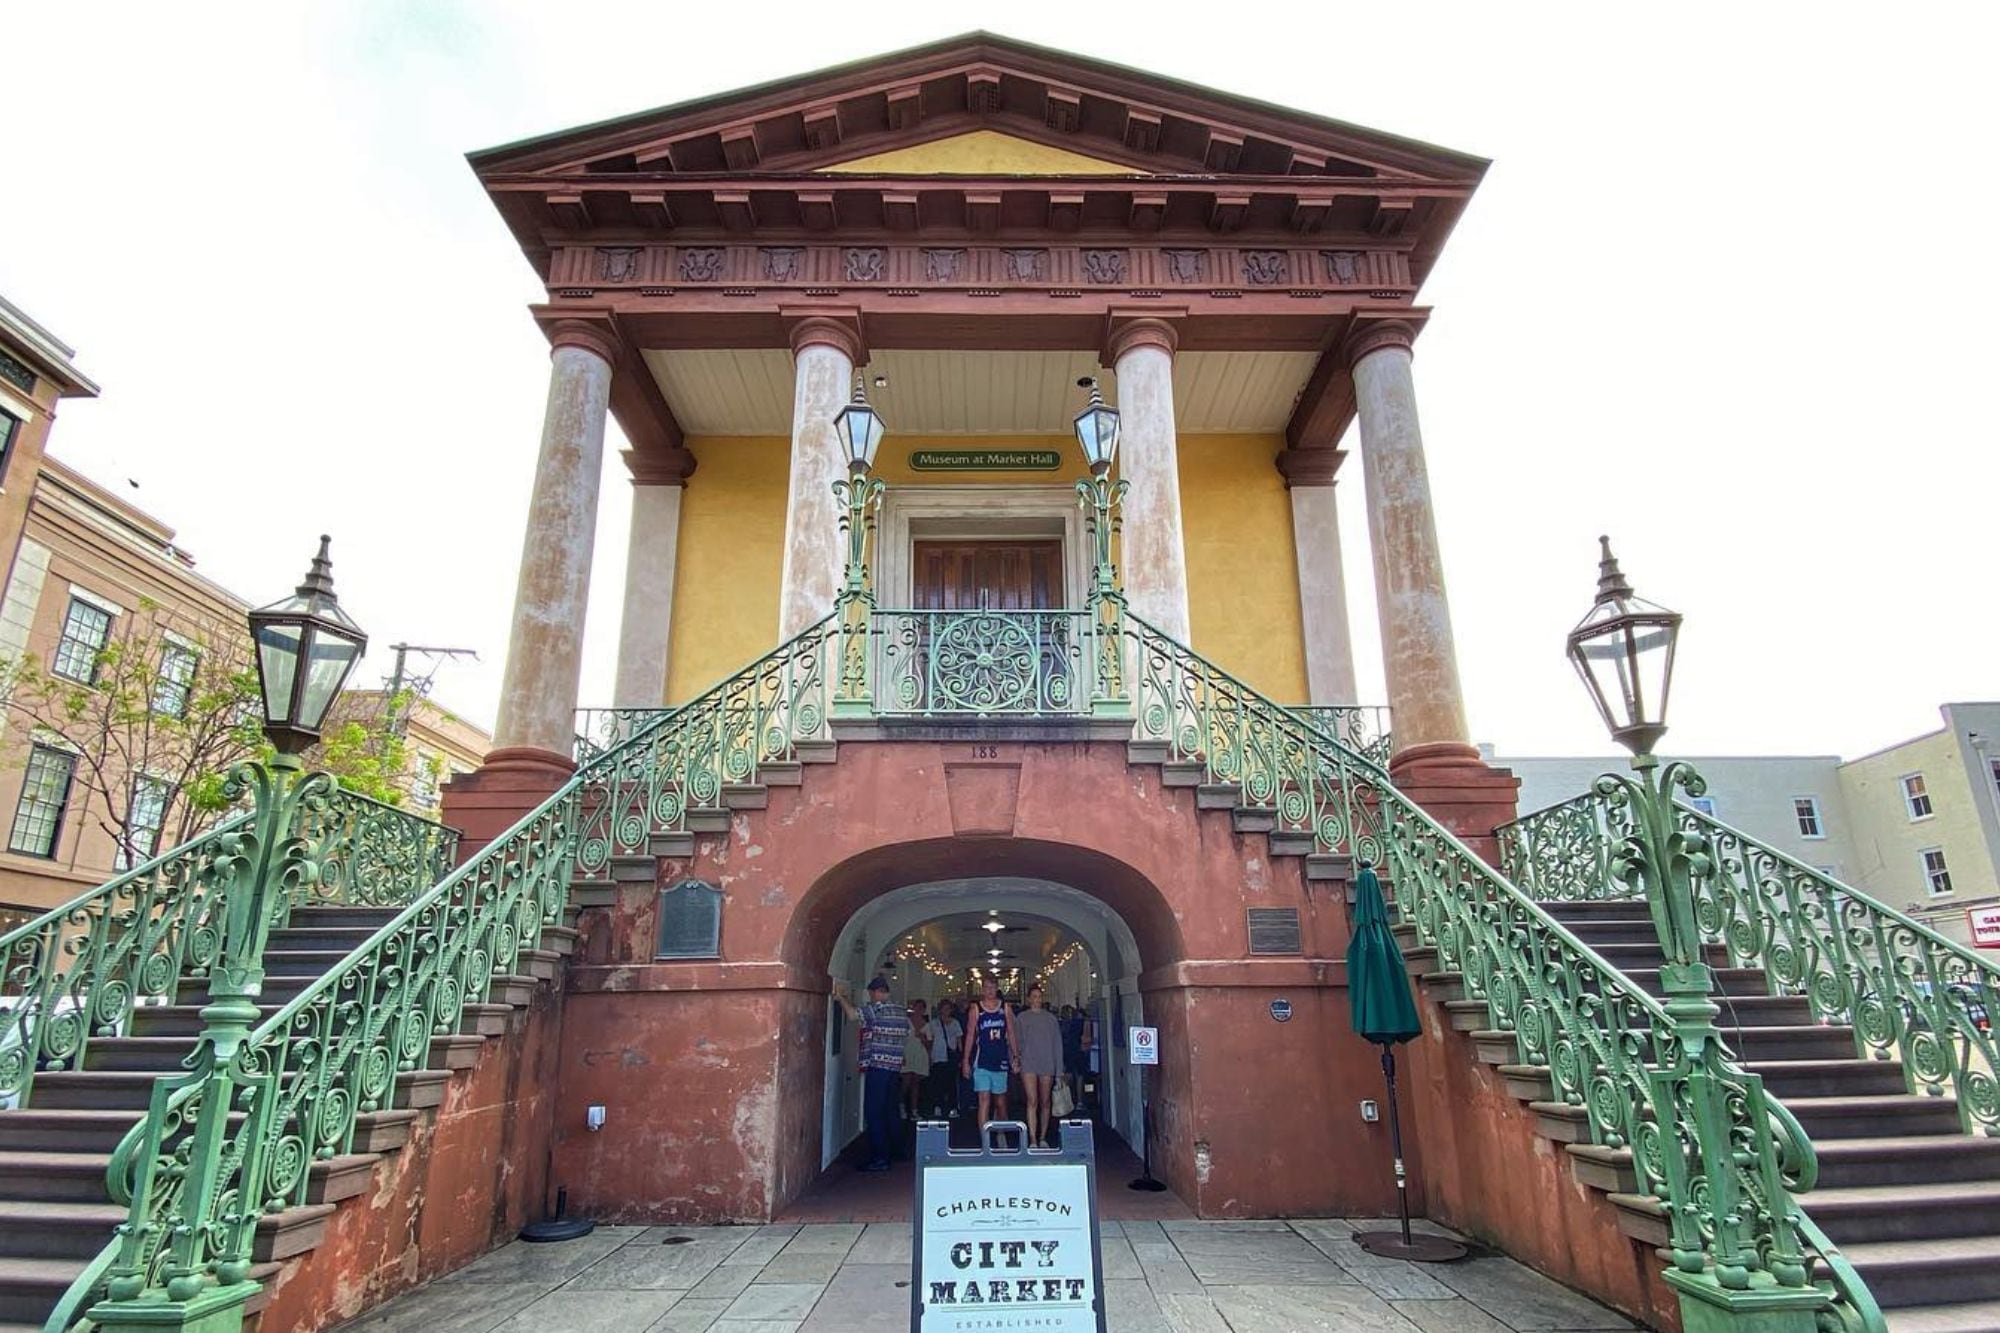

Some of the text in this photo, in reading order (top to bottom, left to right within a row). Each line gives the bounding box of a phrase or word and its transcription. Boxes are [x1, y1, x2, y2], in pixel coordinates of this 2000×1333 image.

[919, 453, 1053, 465] Museum at Market Hall
[936, 1197, 1072, 1218] CHARLESTON
[950, 1240, 1059, 1269] CITY
[929, 1279, 1085, 1304] MARKET
[956, 1318, 1063, 1329] ESTABLISHED
